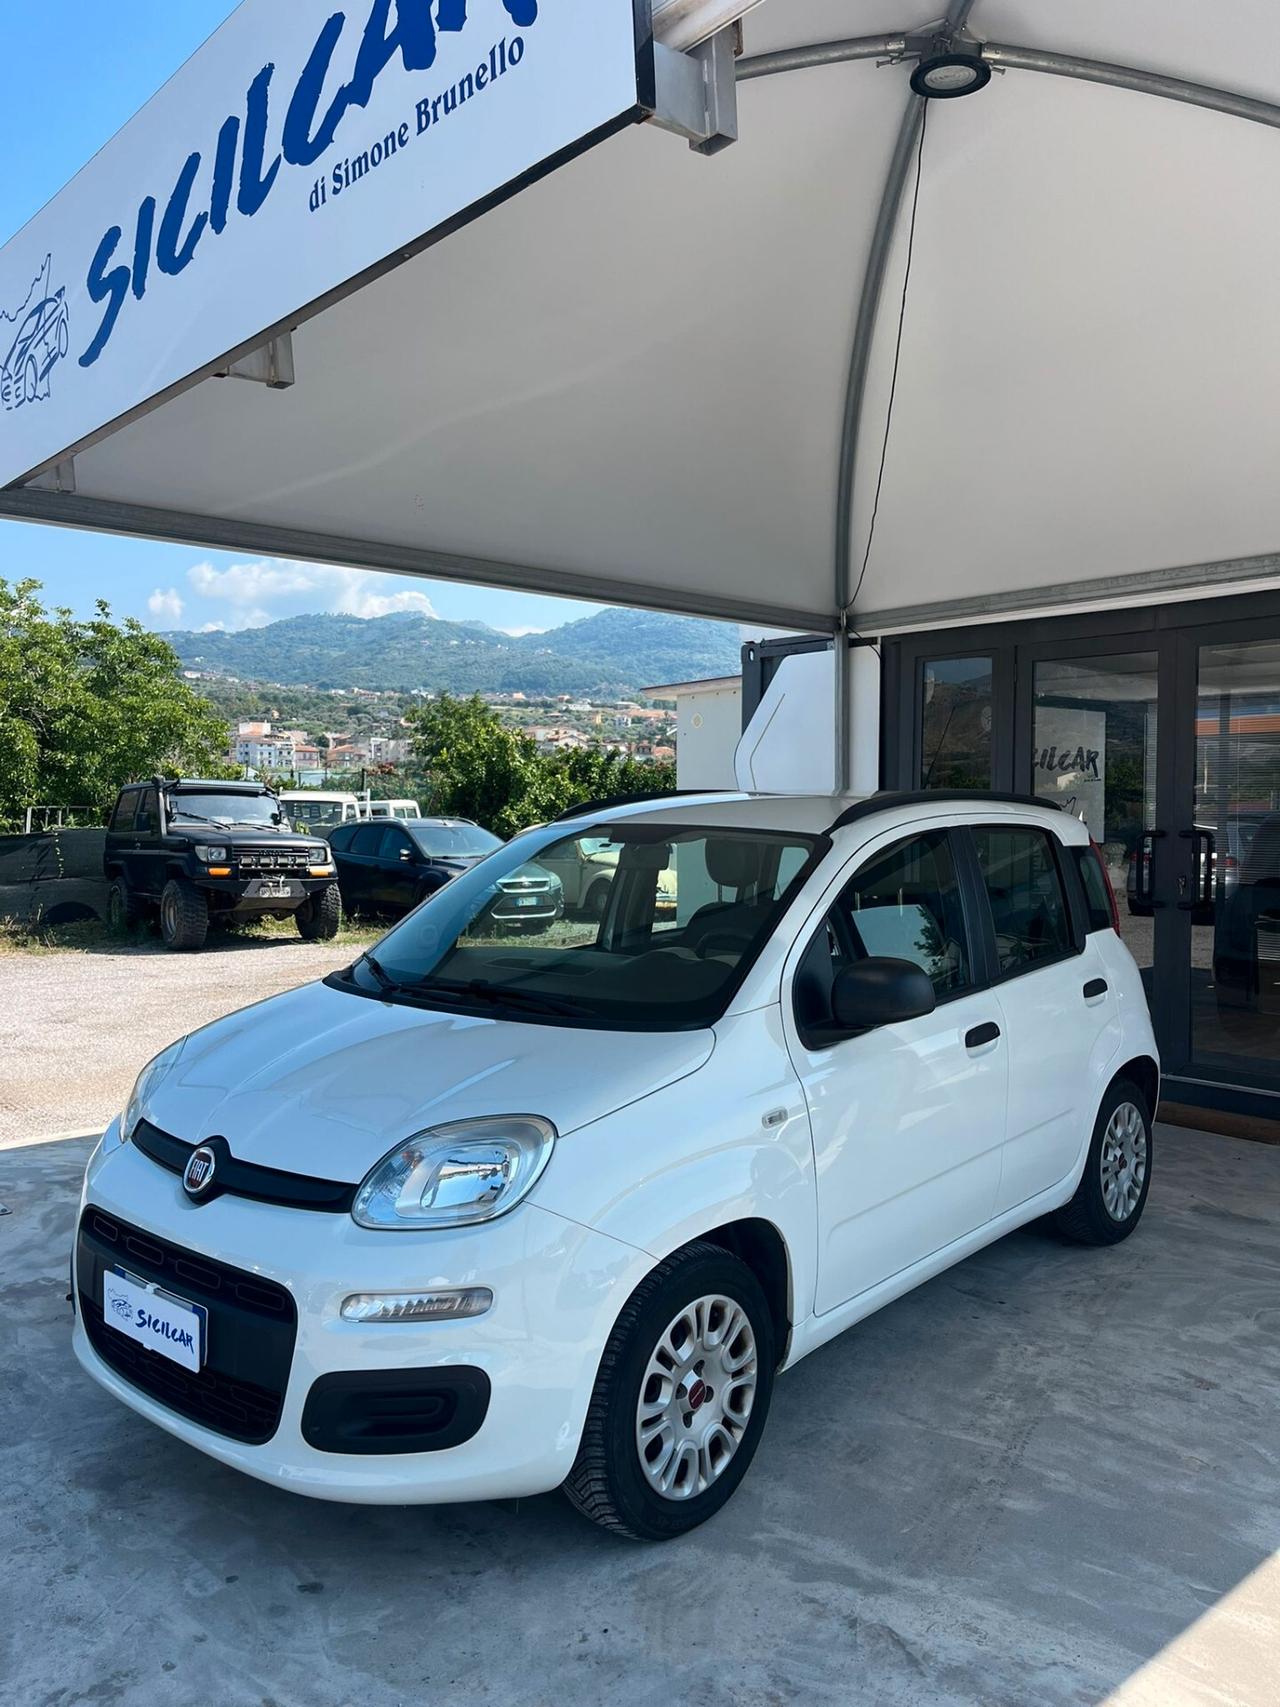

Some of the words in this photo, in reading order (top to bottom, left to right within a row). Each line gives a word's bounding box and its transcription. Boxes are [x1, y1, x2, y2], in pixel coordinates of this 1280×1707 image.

[308, 176, 327, 212] di
[332, 122, 410, 195] Simone
[415, 36, 525, 136] Brunello
[79, 0, 538, 367] SICILCA
[188, 1158, 209, 1182] FIAT
[135, 1309, 195, 1354] SICILCAR
